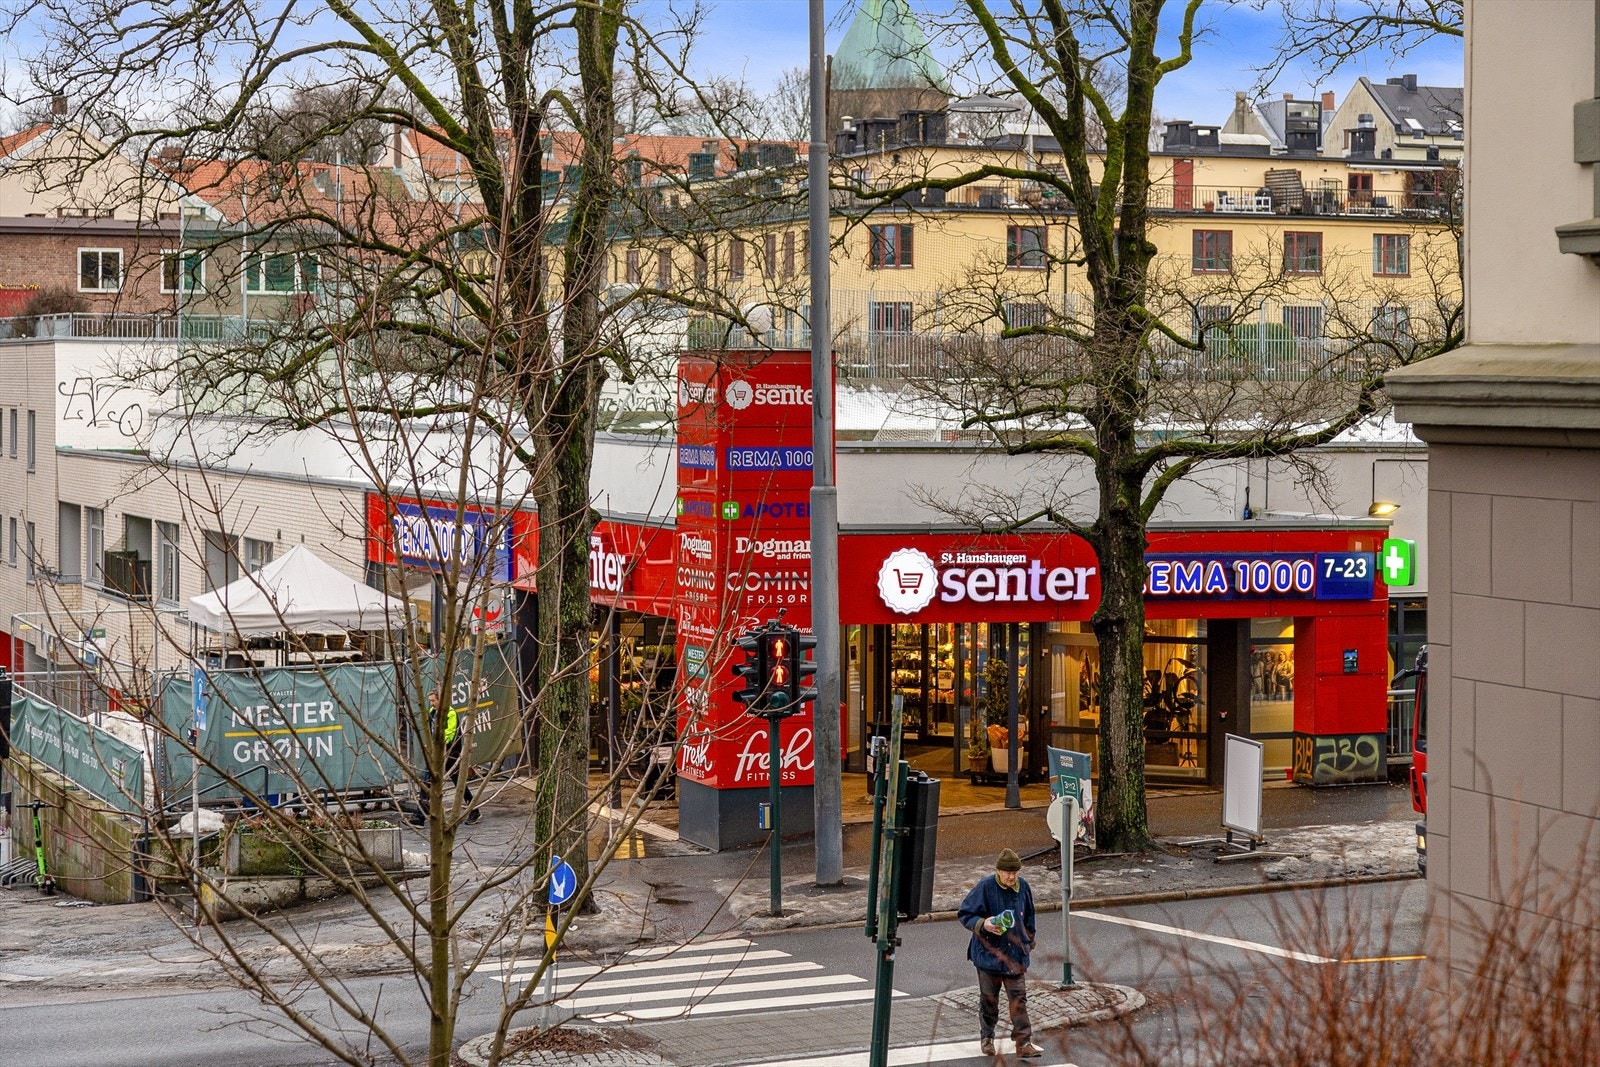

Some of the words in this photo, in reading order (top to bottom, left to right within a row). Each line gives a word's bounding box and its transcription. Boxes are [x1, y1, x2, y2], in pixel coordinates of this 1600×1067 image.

[754, 385, 813, 405] sente
[729, 450, 782, 467] REMA
[785, 450, 813, 467] 100
[742, 502, 811, 518] APOTE
[681, 532, 712, 555] Dogman
[777, 552, 791, 560] and
[793, 552, 811, 560] frien
[941, 552, 955, 564] St.
[956, 552, 1027, 565] Hanshaugen
[1142, 560, 1227, 595] EMA
[1234, 559, 1315, 594] 1000
[1324, 557, 1367, 579] 7-23
[726, 571, 812, 592] COMIN
[940, 558, 1096, 603] senter
[747, 594, 807, 604] FRISØR
[231, 700, 336, 728] MESTER
[232, 735, 334, 763] GRØNN
[746, 771, 796, 782] FITNSS
